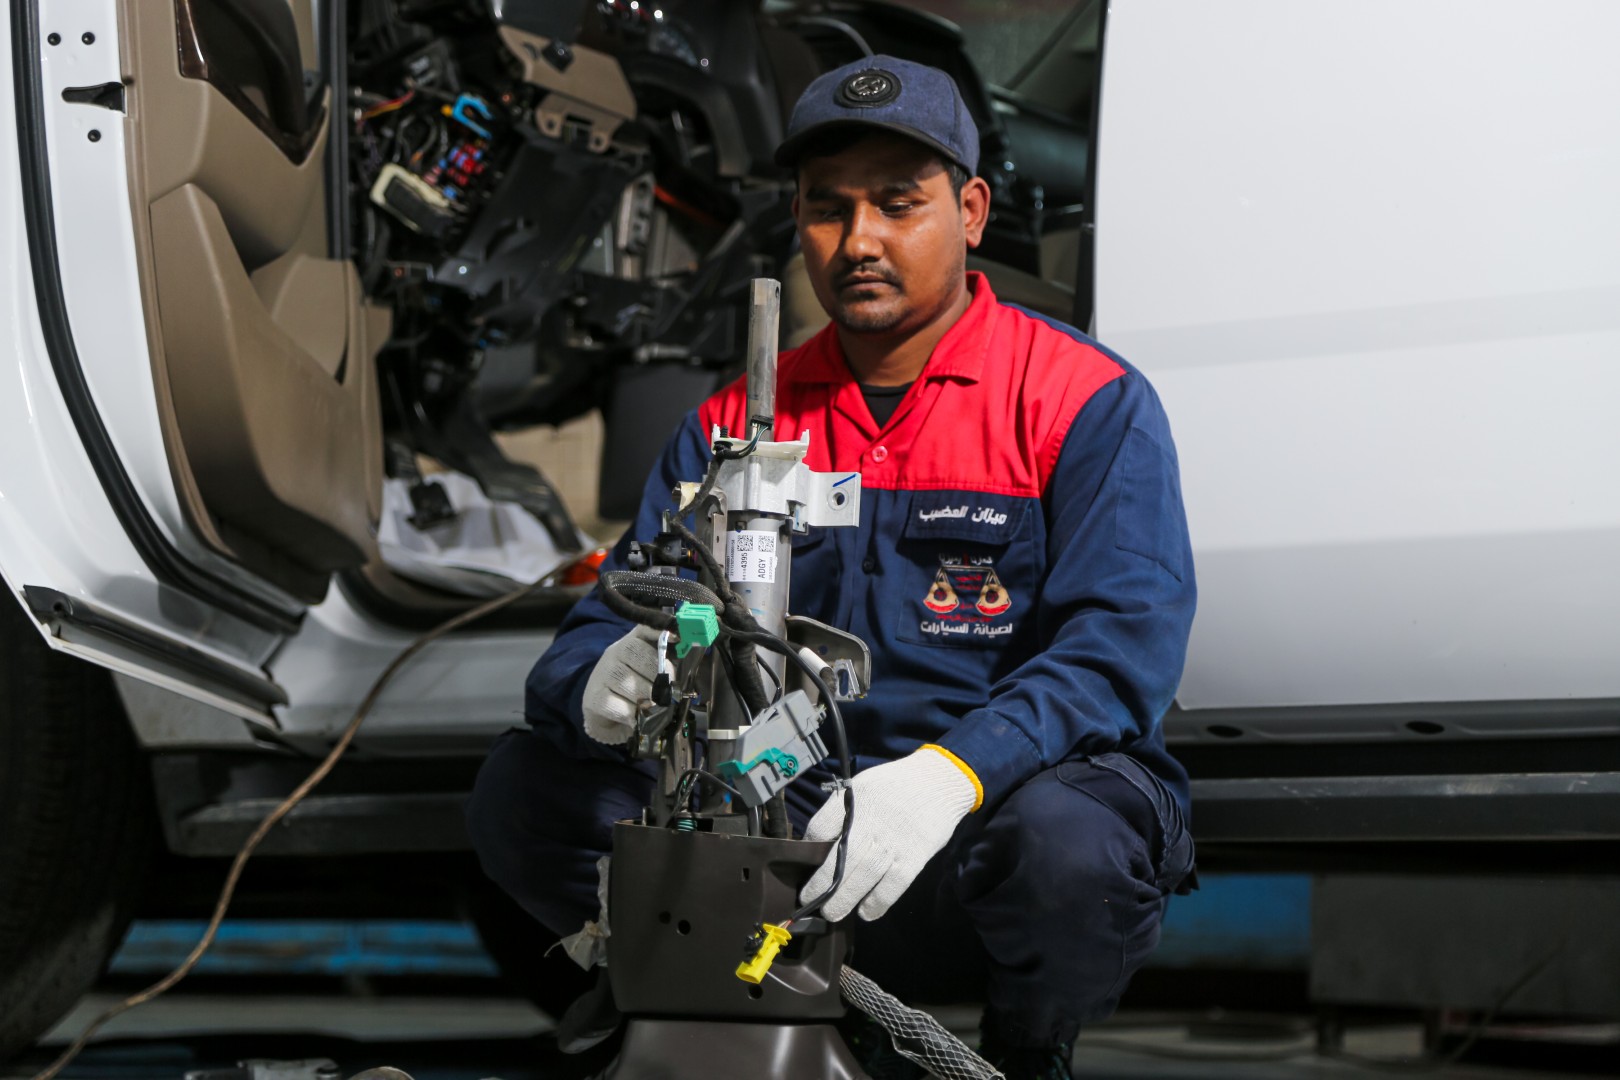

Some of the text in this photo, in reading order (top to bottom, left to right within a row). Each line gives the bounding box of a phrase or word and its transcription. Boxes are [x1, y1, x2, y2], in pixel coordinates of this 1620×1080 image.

[971, 507, 1007, 525] ميزان
[758, 558, 766, 579] ADGY
[920, 621, 1013, 638] لصيانة السيارات
